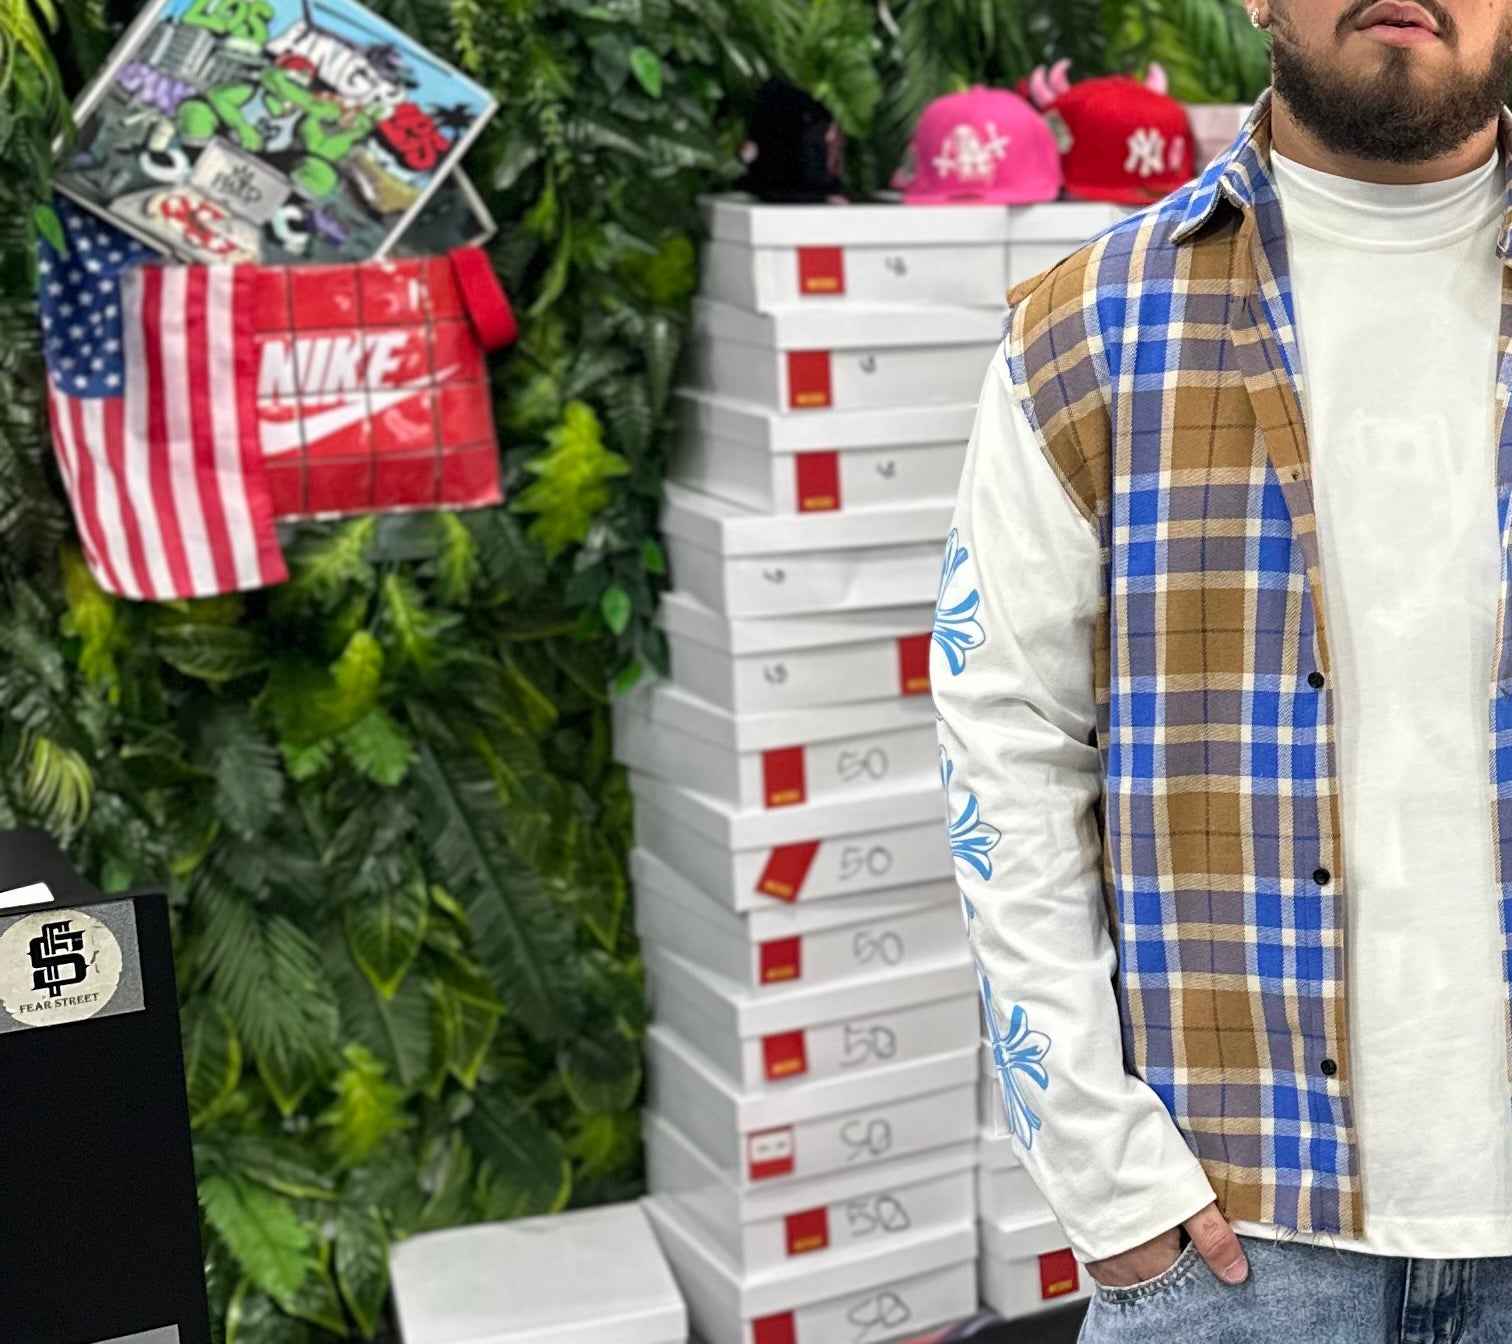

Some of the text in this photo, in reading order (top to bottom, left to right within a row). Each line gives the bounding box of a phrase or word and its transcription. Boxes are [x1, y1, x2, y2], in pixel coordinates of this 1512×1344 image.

[256, 332, 408, 405] NIKE
[836, 747, 890, 783] 50
[838, 845, 893, 881] 50
[853, 930, 905, 967] 50
[19, 992, 100, 1014] FEAR STREET
[840, 1024, 896, 1069] 50
[849, 1195, 911, 1237] 50
